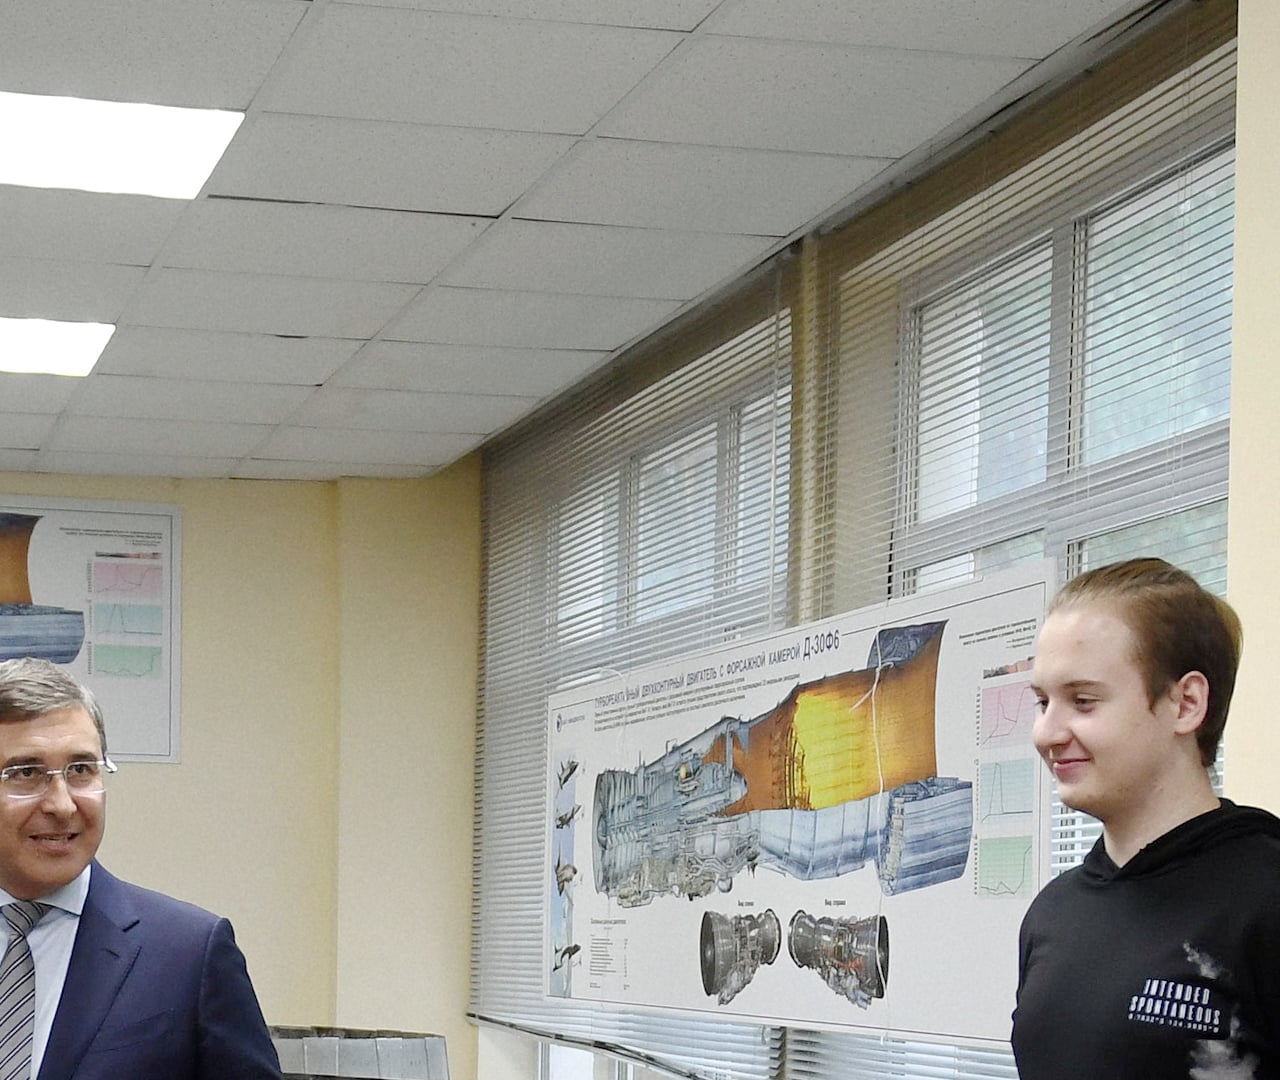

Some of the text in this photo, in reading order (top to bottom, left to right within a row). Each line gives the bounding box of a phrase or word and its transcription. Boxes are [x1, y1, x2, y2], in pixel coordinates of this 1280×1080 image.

[803, 629, 840, 662] Д-30Ф6
[1143, 979, 1210, 1005] INTENDED
[1129, 996, 1220, 1025] SPONTANEOUS
